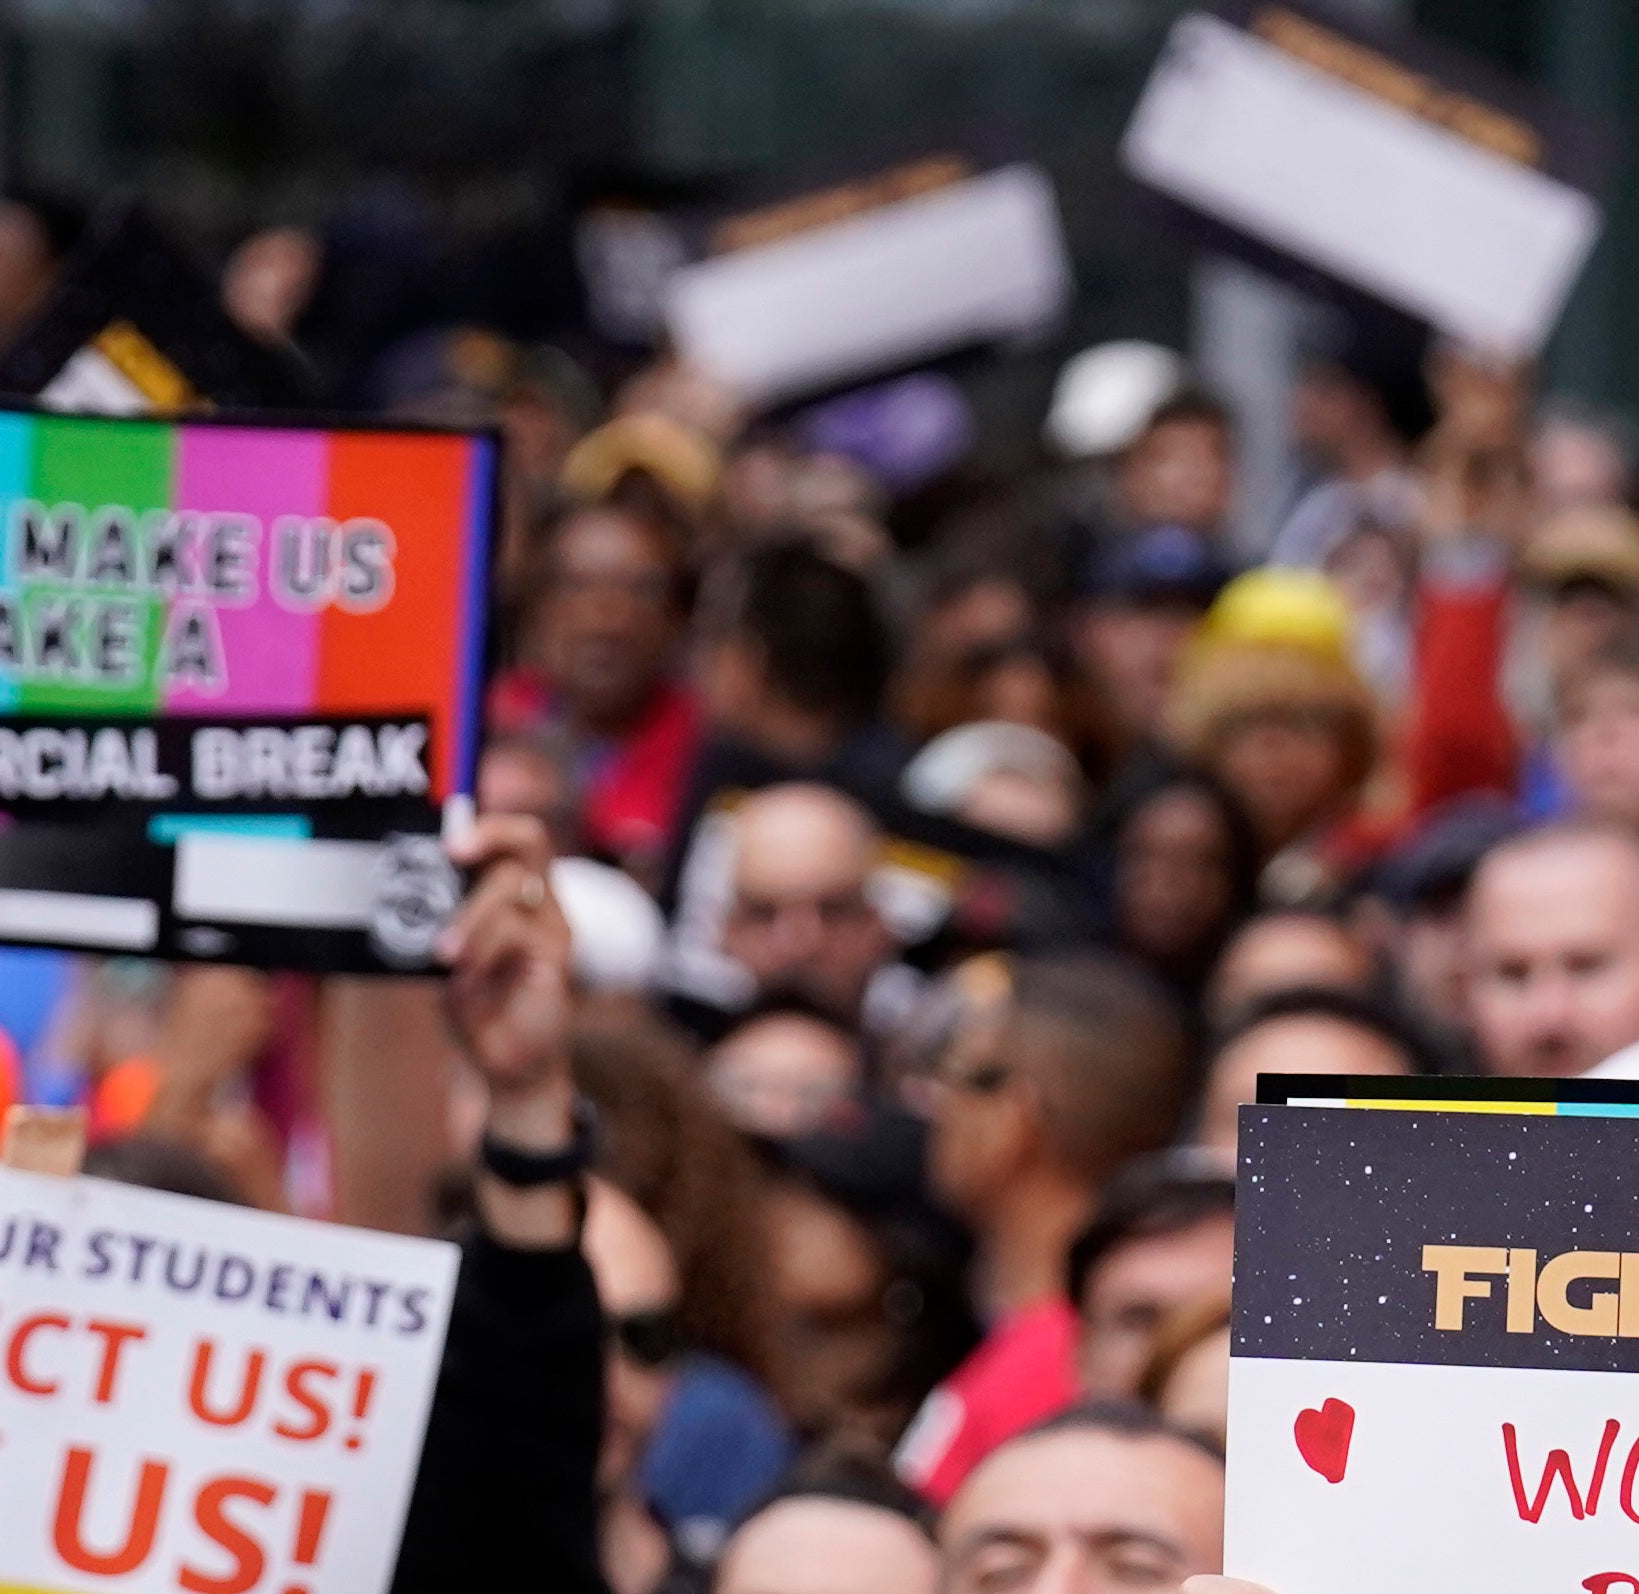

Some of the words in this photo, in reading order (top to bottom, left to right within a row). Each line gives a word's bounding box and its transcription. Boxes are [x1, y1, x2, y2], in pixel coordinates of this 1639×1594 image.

[18, 507, 254, 598] MAKE
[277, 522, 389, 600] US
[167, 610, 224, 689] A
[191, 723, 432, 798] BREAK
[84, 1230, 433, 1336] STUDENTS
[186, 1338, 378, 1450] US!
